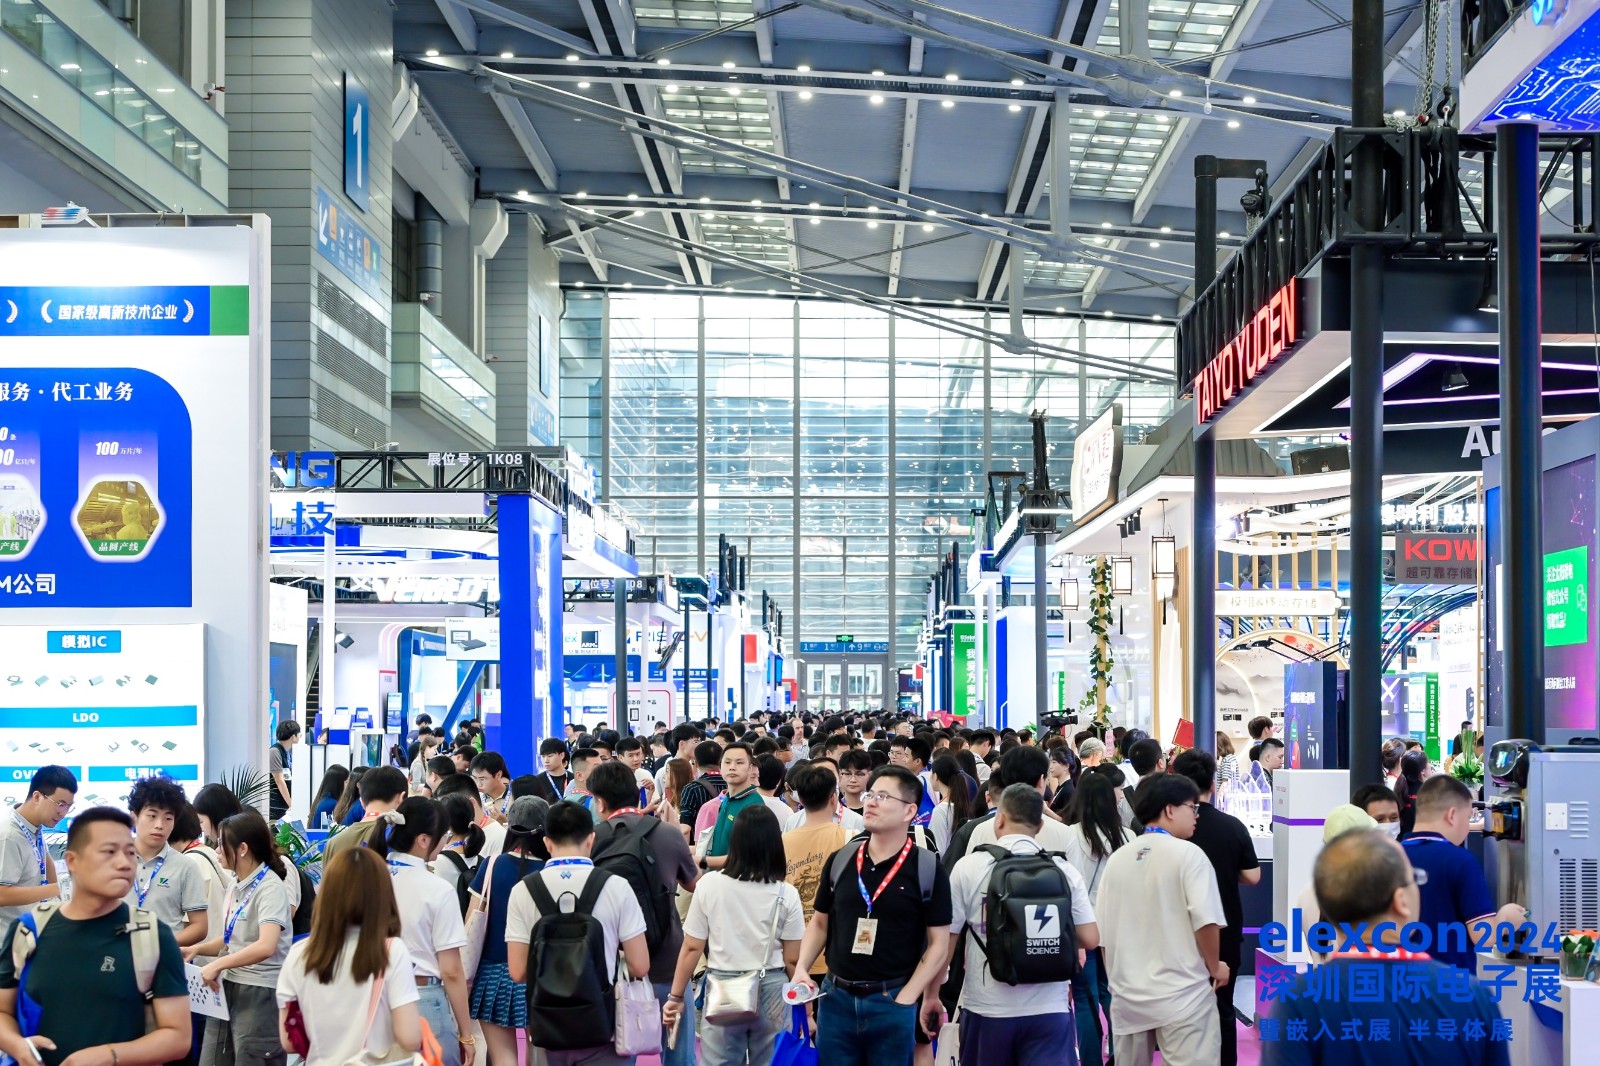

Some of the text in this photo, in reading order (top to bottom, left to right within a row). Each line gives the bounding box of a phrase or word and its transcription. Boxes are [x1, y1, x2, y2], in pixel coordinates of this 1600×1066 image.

[58, 304, 178, 321] 国家级高新技术企业
[1195, 276, 1296, 425] TAIYO YUDEN
[95, 441, 119, 456] 100
[486, 453, 523, 466] 1K08
[1406, 566, 1478, 579] 超可靠存储
[61, 634, 107, 648] 模拟IC
[72, 712, 99, 723] LDO
[1026, 938, 1060, 947] SWITCH
[1026, 947, 1060, 955] SCIENCE
